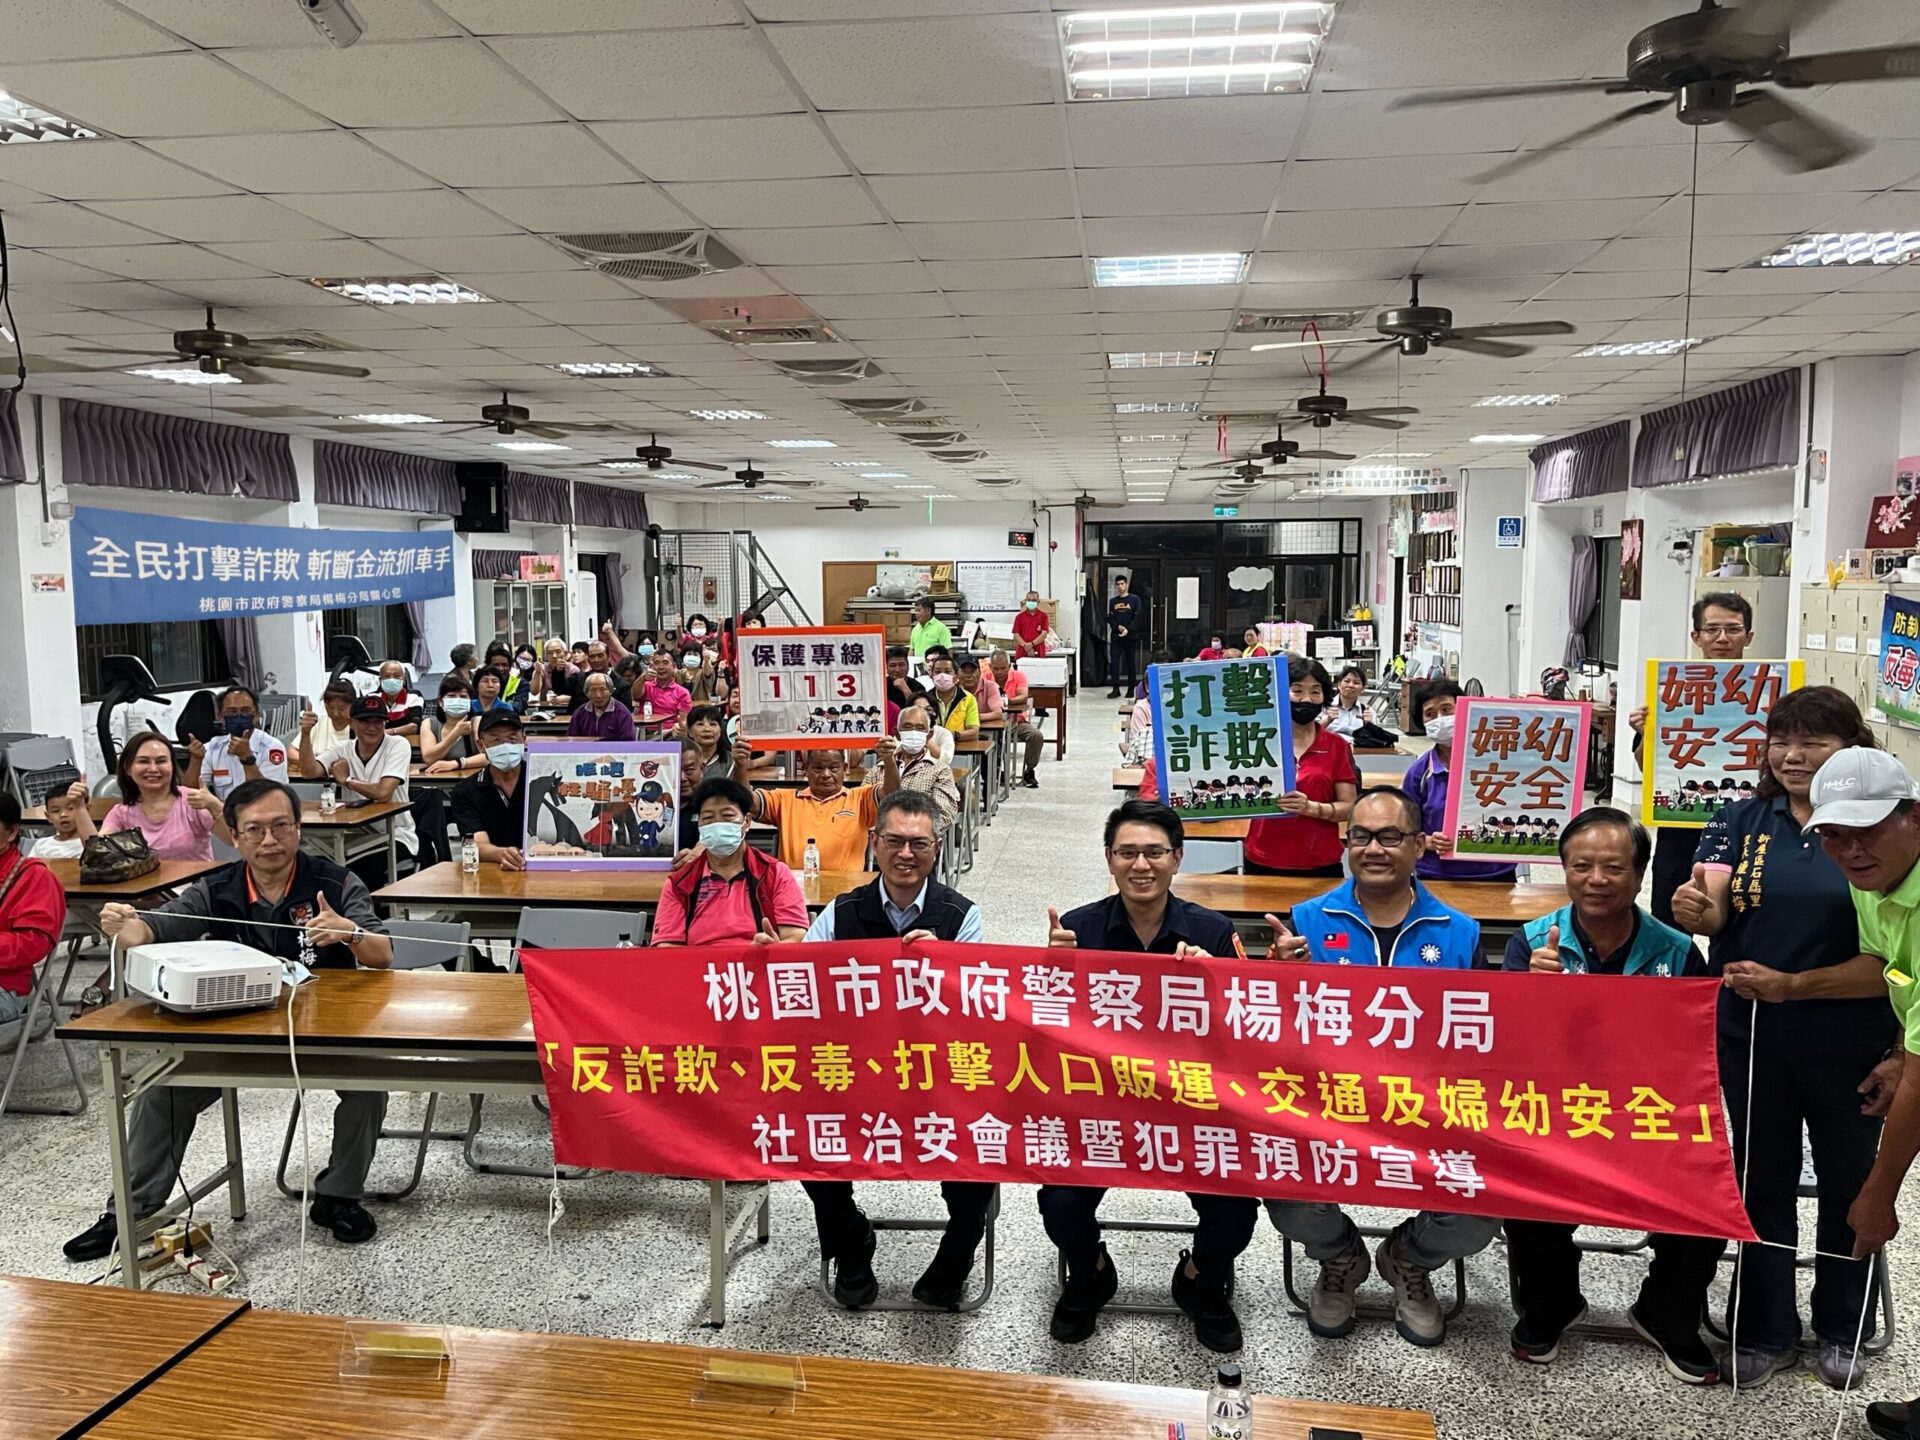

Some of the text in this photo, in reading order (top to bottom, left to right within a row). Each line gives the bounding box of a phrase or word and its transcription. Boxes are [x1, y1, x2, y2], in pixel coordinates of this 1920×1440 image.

[87, 536, 450, 582] 全民打擊詐欺 斬斷金流抓車手
[199, 587, 402, 613] 桃園市政府警察局楊梅分局關心您
[1891, 611, 1918, 638] 防制
[751, 643, 865, 667] 保護專線
[1884, 646, 1920, 690] 反毒
[1163, 663, 1274, 719] 打擊
[1660, 663, 1782, 715] 婦幼
[1167, 721, 1278, 772] 詐欺
[1471, 716, 1573, 762] 婦幼
[1661, 717, 1768, 771] 安全
[1470, 762, 1571, 809] 安全
[703, 957, 1495, 1053] 桃園市政府警察局楊梅分局
[544, 1039, 1713, 1143] 「反詐欺、反毒、打擊人口販運、交通及婦幼安全」
[752, 1111, 1487, 1198] 社區治安會議暨犯罪預防宣導
